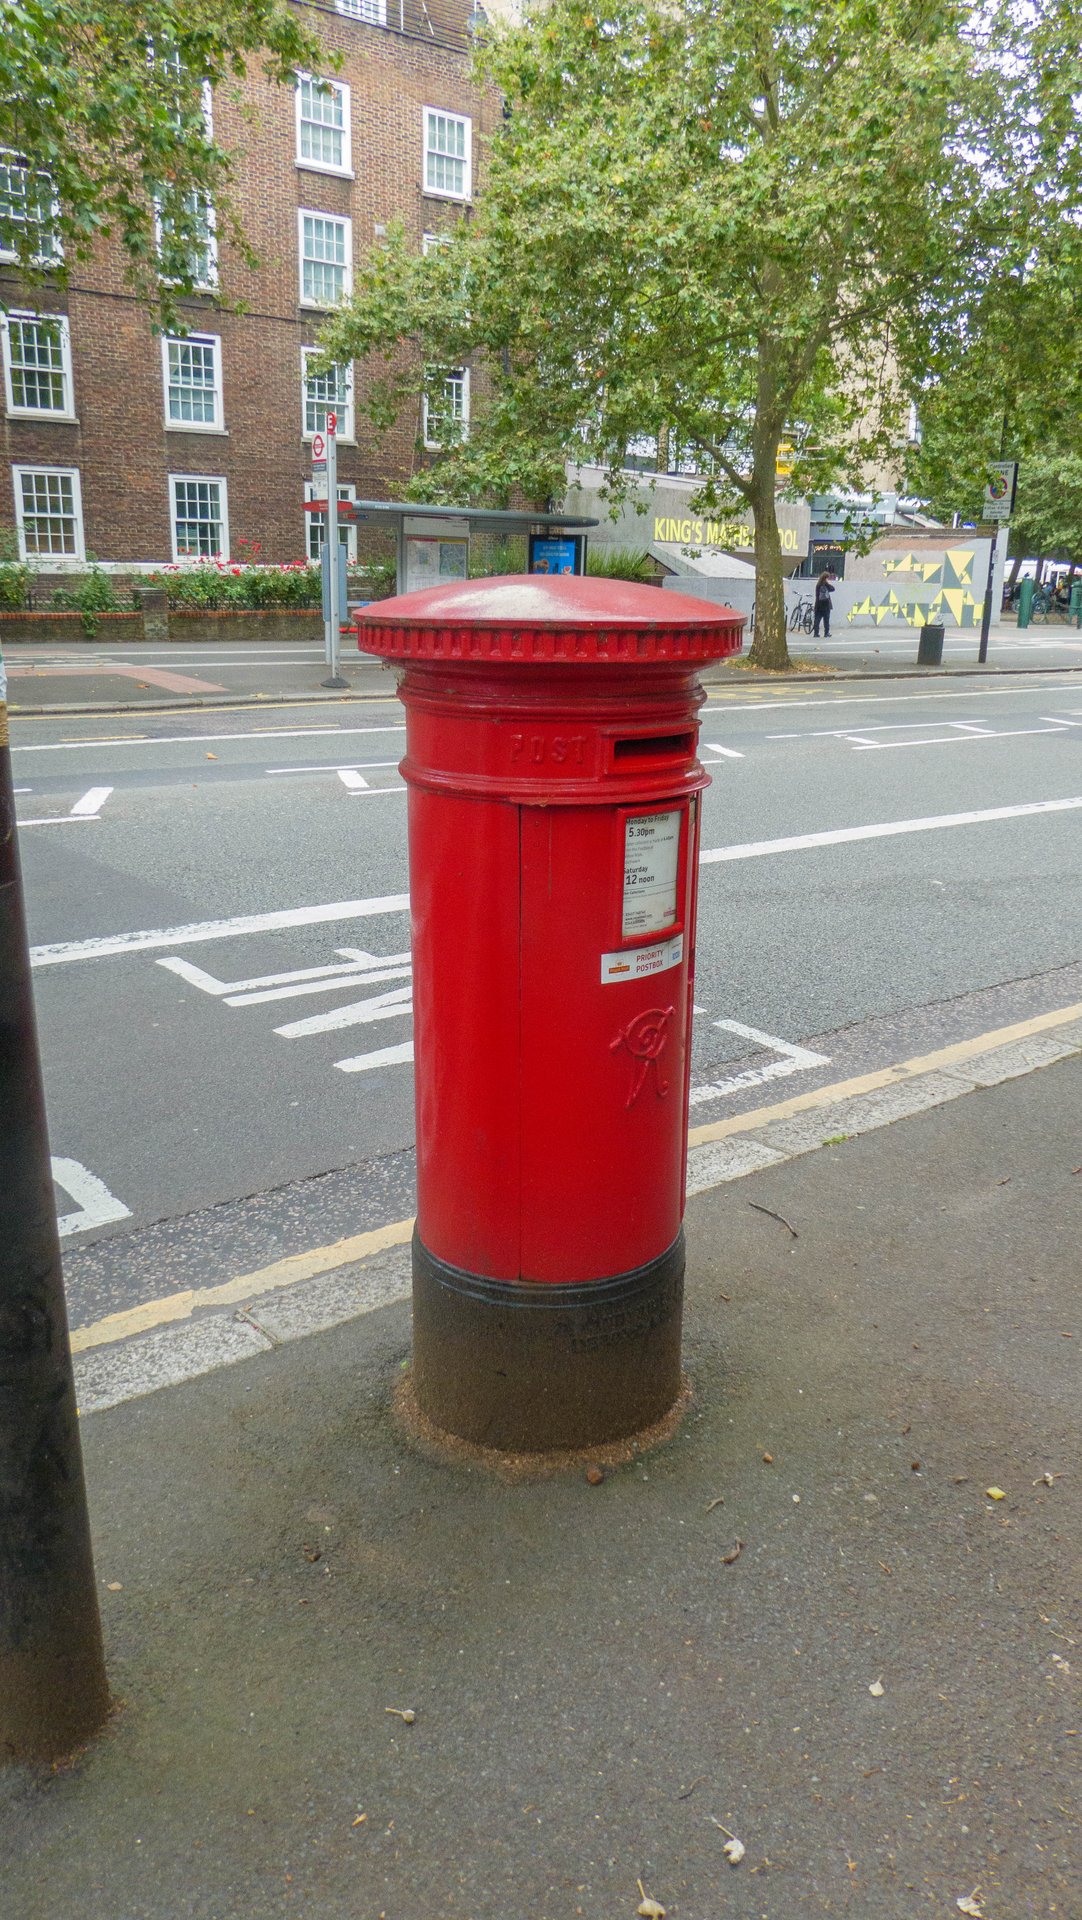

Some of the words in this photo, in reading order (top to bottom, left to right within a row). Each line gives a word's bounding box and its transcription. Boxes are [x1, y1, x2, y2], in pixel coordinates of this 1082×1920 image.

[327, 415, 333, 429] E
[654, 517, 703, 544] KING'S
[510, 734, 587, 764] POST
[654, 814, 669, 822] Friday
[628, 826, 655, 838] 5.30pm
[625, 874, 637, 885] 12
[638, 875, 655, 883] noon
[636, 950, 664, 962] PRIORITY
[636, 960, 664, 973] POSTBOX
